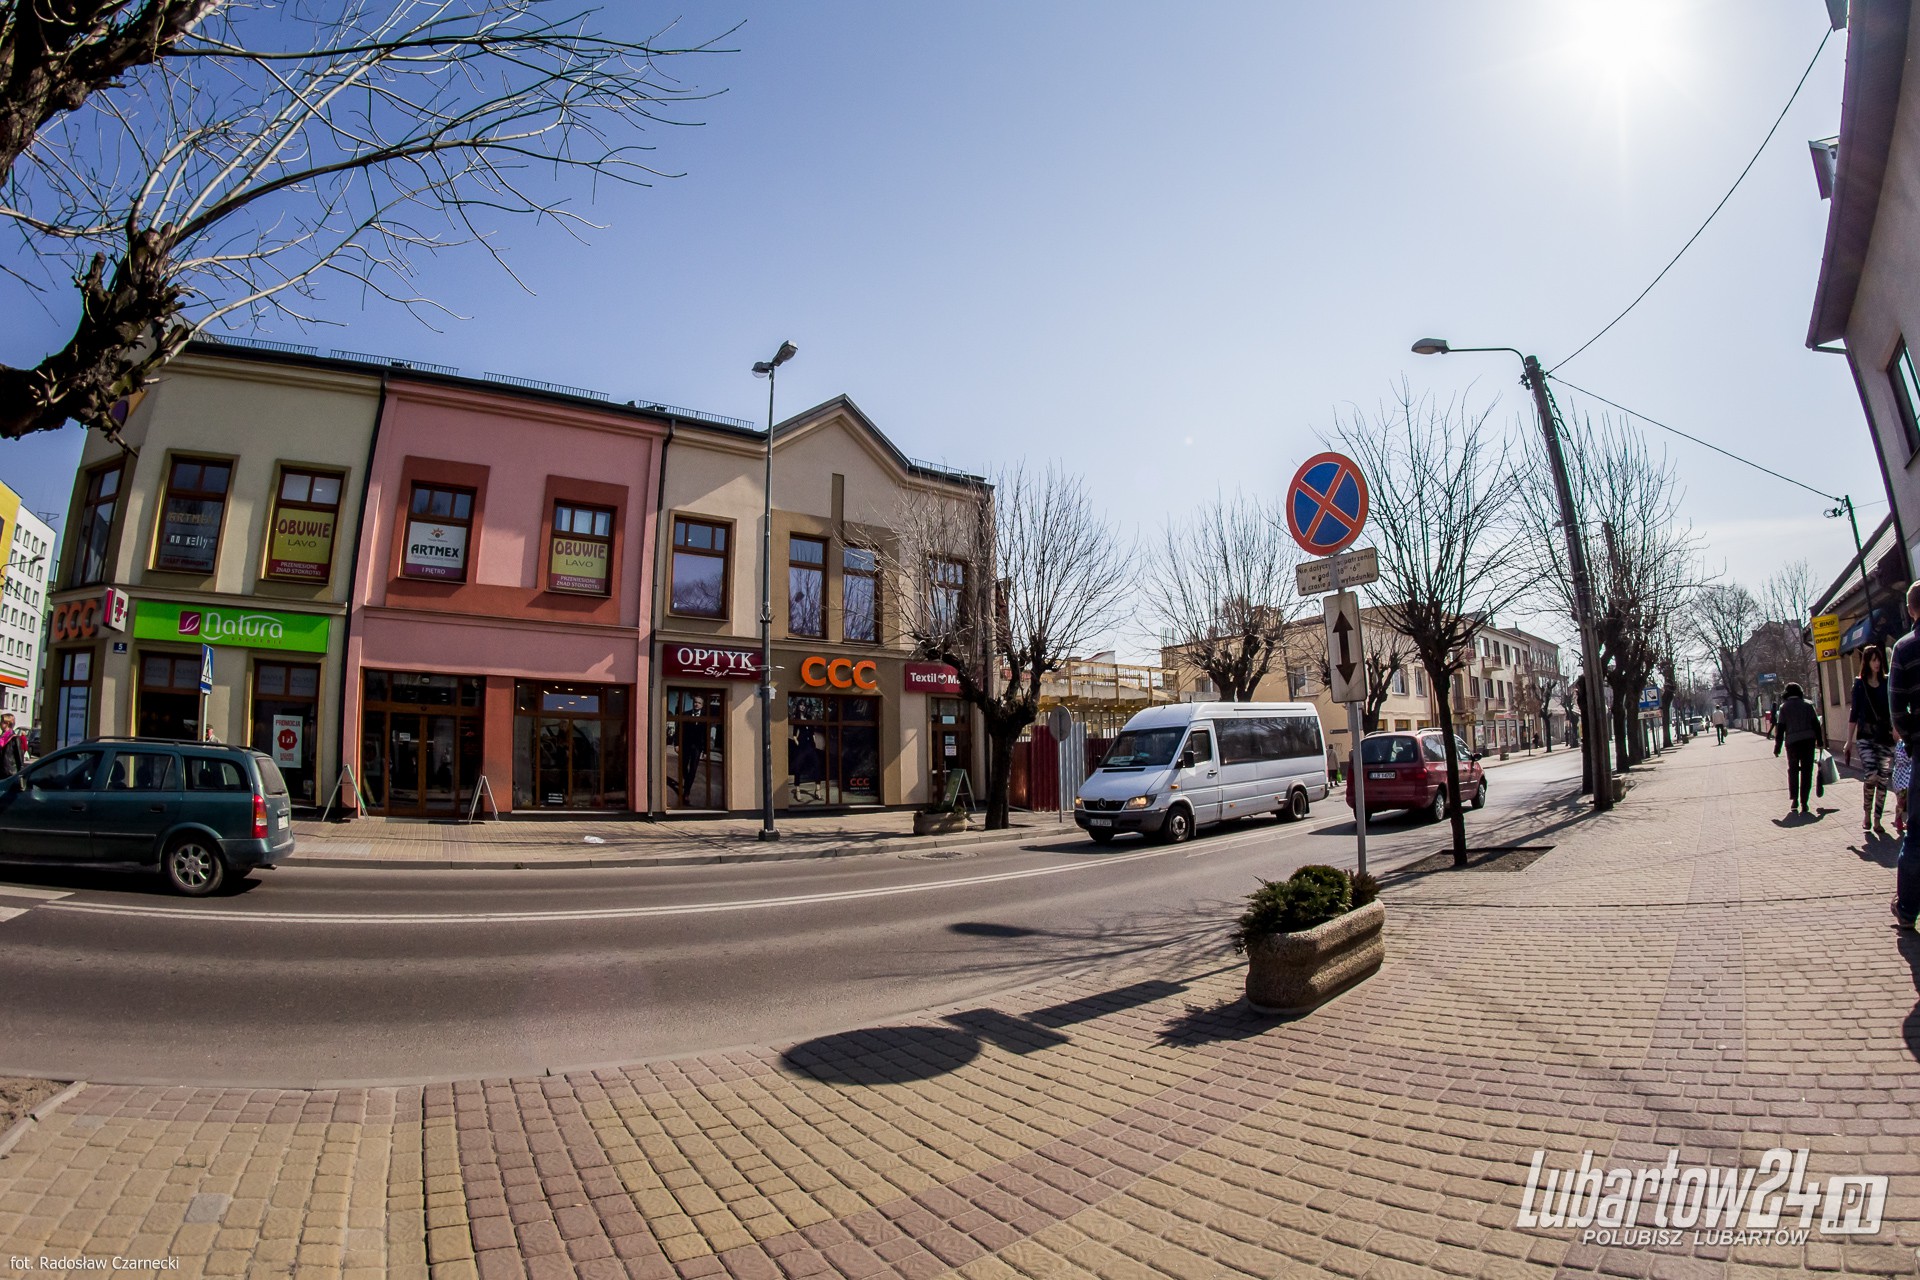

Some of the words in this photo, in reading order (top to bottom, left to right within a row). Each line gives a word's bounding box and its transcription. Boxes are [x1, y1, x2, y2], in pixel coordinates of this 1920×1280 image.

[278, 518, 331, 539] OBUWIE
[288, 539, 317, 548] LAVO
[411, 544, 459, 558] ARTMEX
[555, 541, 606, 559] OBUWIE
[565, 559, 594, 568] LAVO
[1307, 582, 1326, 591] czasie
[53, 599, 97, 640] CCC
[677, 647, 755, 669] OPTYK
[704, 666, 729, 677] Styl
[801, 656, 877, 690] CCC
[910, 672, 937, 683] Textil
[850, 777, 870, 786] CCC
